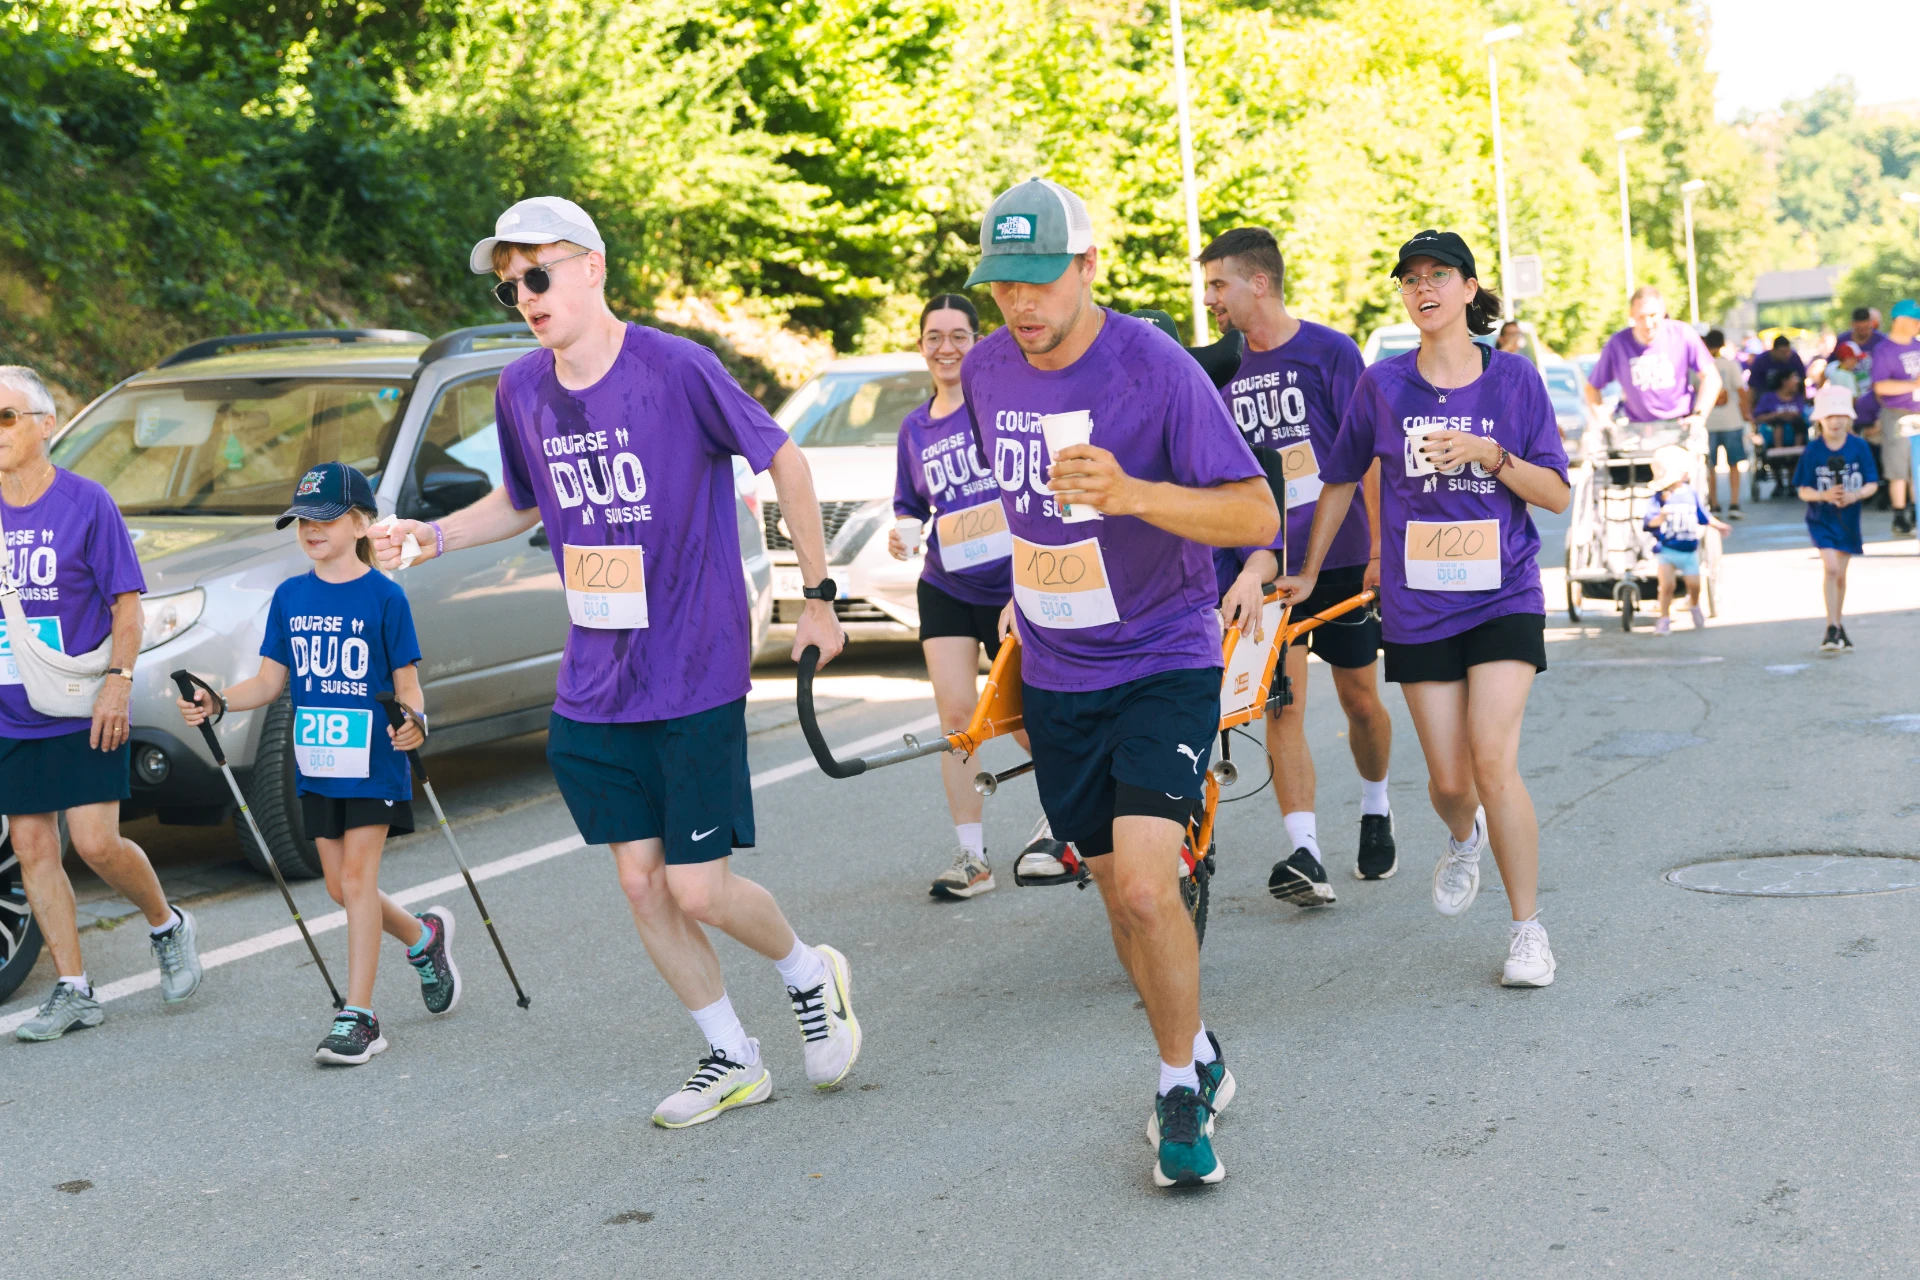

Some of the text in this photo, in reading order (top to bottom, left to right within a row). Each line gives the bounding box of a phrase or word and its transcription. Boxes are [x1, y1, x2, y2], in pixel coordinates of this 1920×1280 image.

[997, 222, 1018, 230] NORTH
[1231, 371, 1280, 395] COURSE
[1233, 386, 1306, 432] DUO
[996, 410, 1054, 433] COUR
[1271, 424, 1311, 440] SUISSE
[543, 430, 609, 457] COURSE
[922, 432, 965, 461] COURSE
[995, 437, 1057, 496] DU
[549, 452, 647, 509] DUO
[962, 476, 998, 497] SUISSE
[1448, 478, 1496, 494] SUISSE
[604, 504, 652, 524] SUISSE
[953, 508, 997, 541] 120
[1426, 525, 1485, 558] 120
[6, 546, 57, 588] UO
[575, 552, 630, 589] 120
[1027, 550, 1086, 585] 120
[1437, 568, 1467, 580] DUO
[584, 601, 609, 616] DUO
[1040, 600, 1072, 616] DUO
[289, 615, 343, 632] COURSE
[290, 635, 369, 680] DUO
[320, 679, 367, 697] SUISSE
[302, 713, 349, 745] 218
[310, 754, 335, 767] DUO
